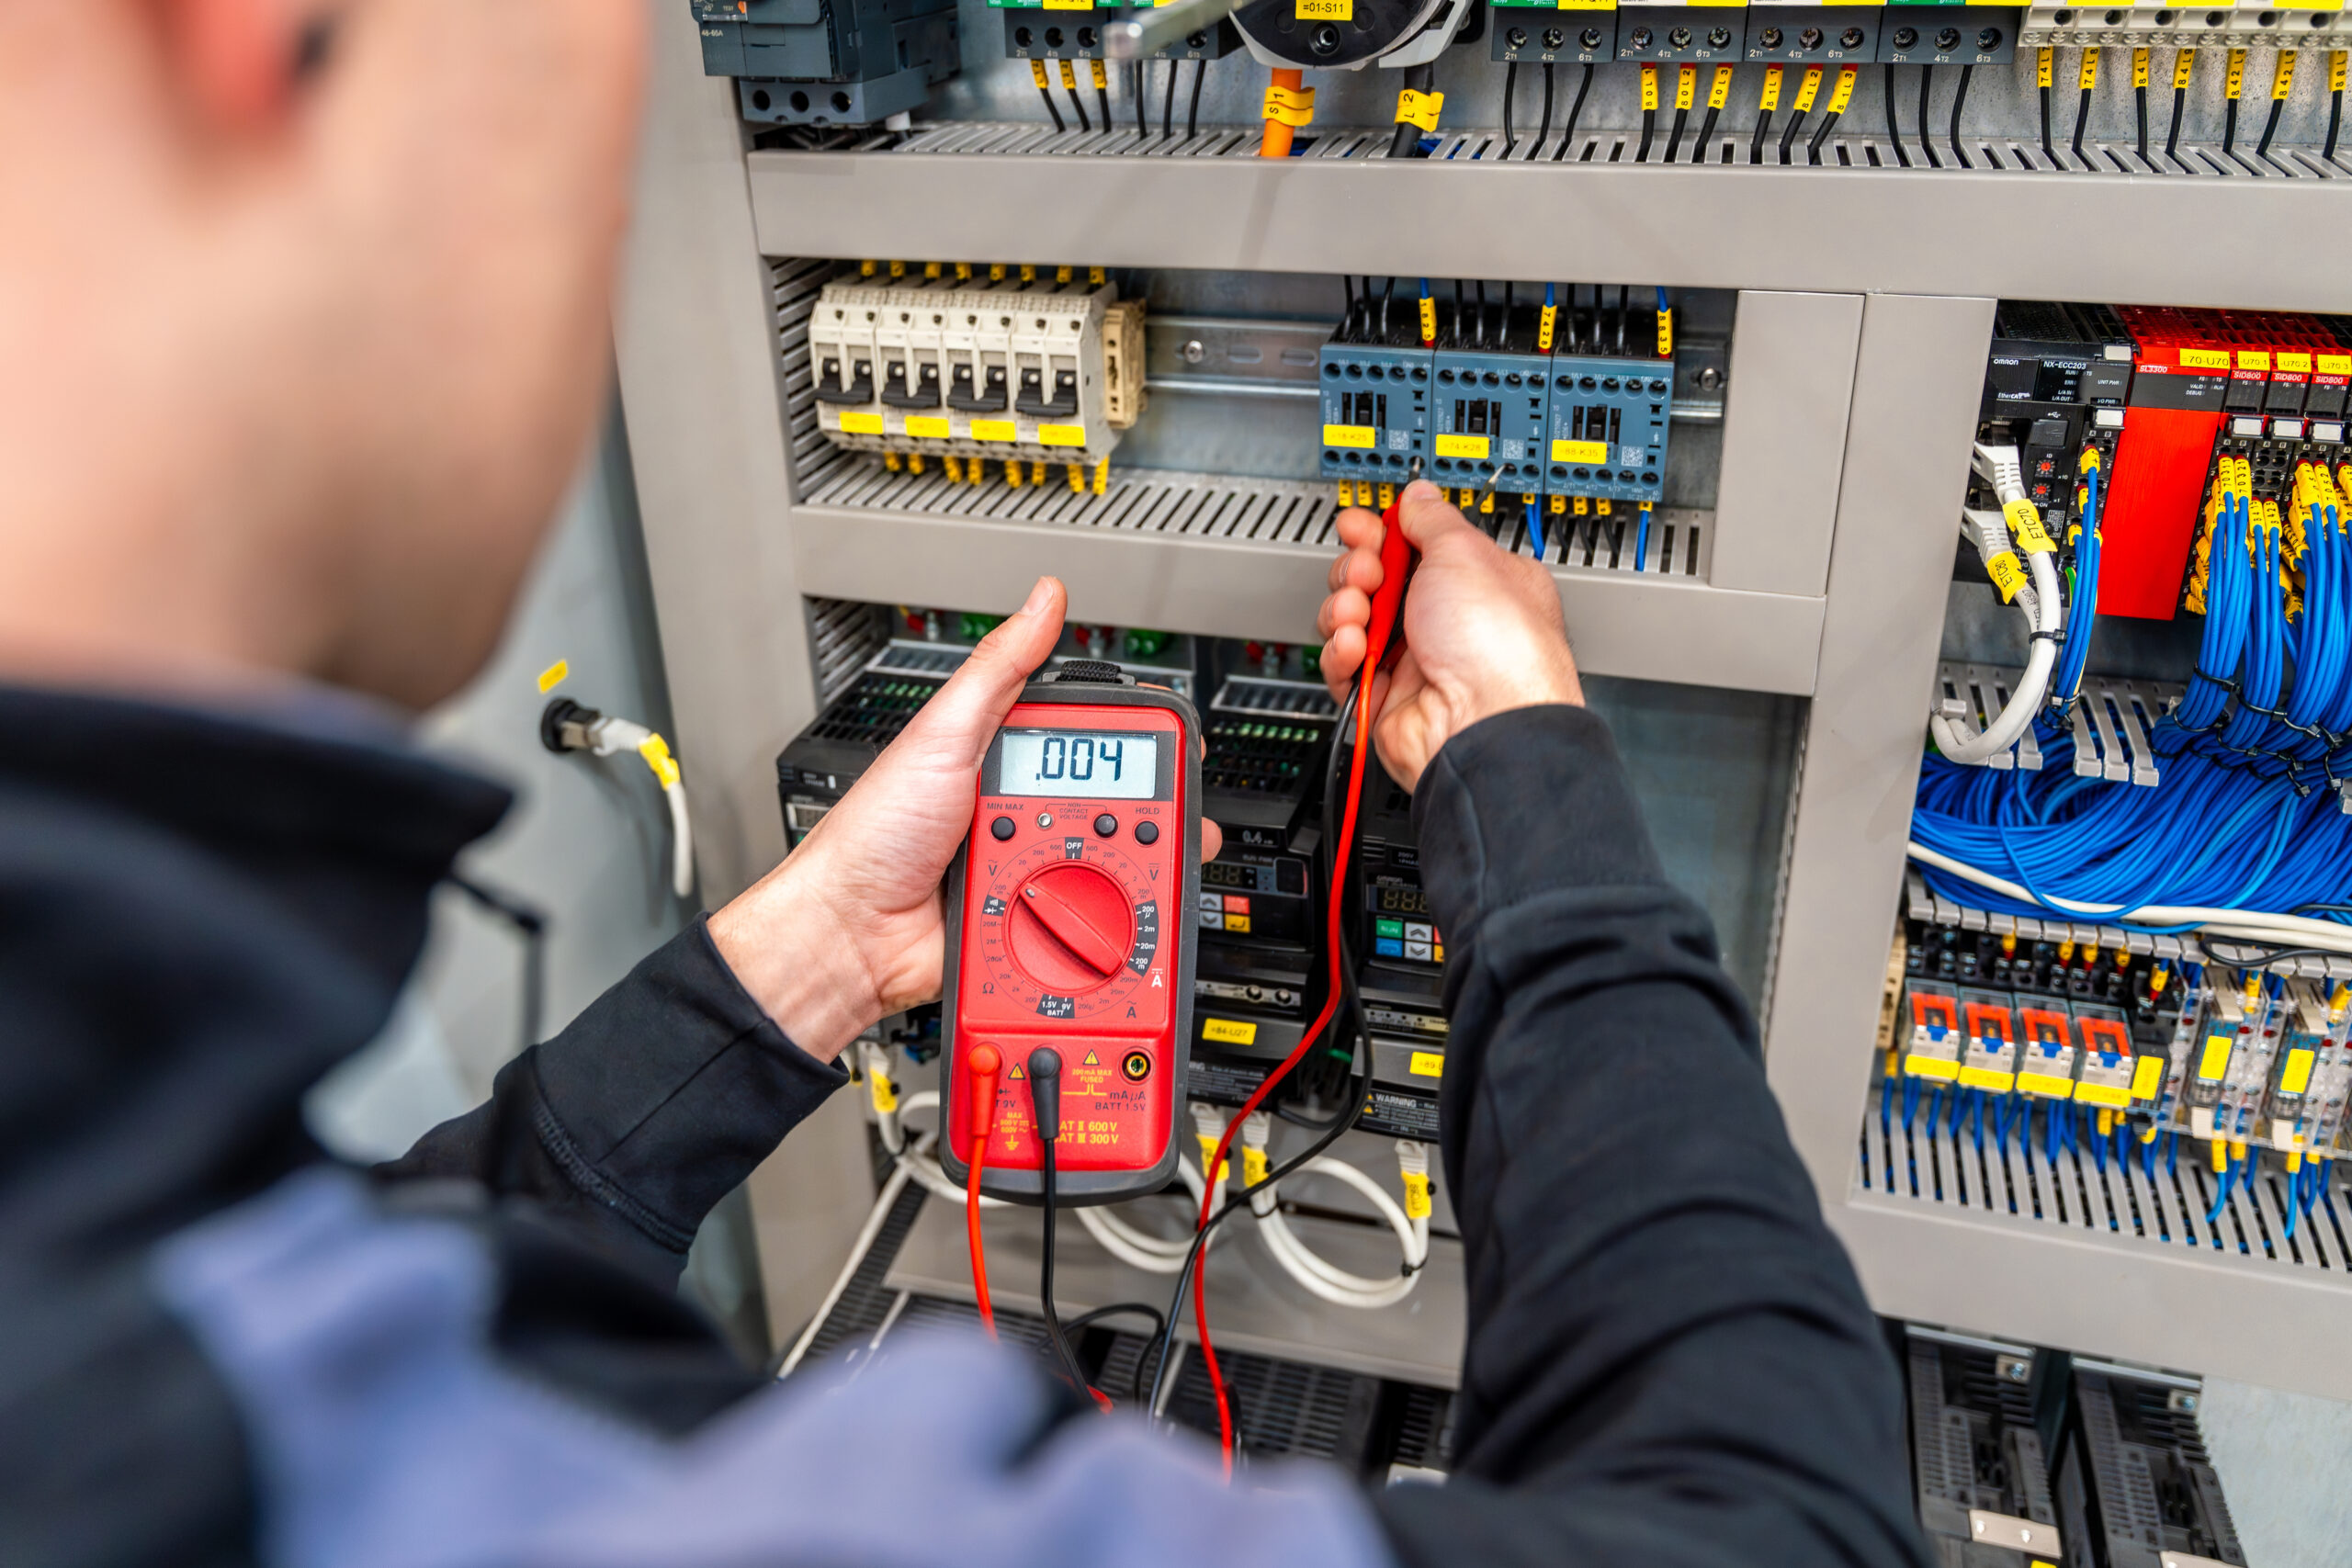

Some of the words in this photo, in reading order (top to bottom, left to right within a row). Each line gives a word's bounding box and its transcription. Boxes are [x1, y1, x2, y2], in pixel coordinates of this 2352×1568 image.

[1303, 3, 1345, 13] =01-S11
[1621, 49, 1634, 57] 2T1
[1658, 50, 1671, 58] 4T2
[1696, 50, 1711, 58] 6T3
[1749, 49, 1763, 58] 2T1
[1789, 50, 1803, 58] 4T2
[1893, 53, 1906, 62] 2T1
[1934, 54, 1950, 62] 4T2
[2043, 361, 2086, 369] NX-ECC203
[2275, 373, 2302, 381] SID800
[2315, 376, 2344, 384] SID800
[2018, 508, 2043, 539] ETC70
[1035, 737, 1123, 782] .004
[987, 802, 1003, 810] MIN
[988, 864, 998, 876] V
[1149, 869, 1159, 881] V
[1151, 975, 1162, 987] A
[1126, 1006, 1136, 1019] A
[1376, 1094, 1417, 1108] WARNING
[1125, 1103, 1146, 1111] 1.5V
[1055, 1133, 1074, 1144] AT
